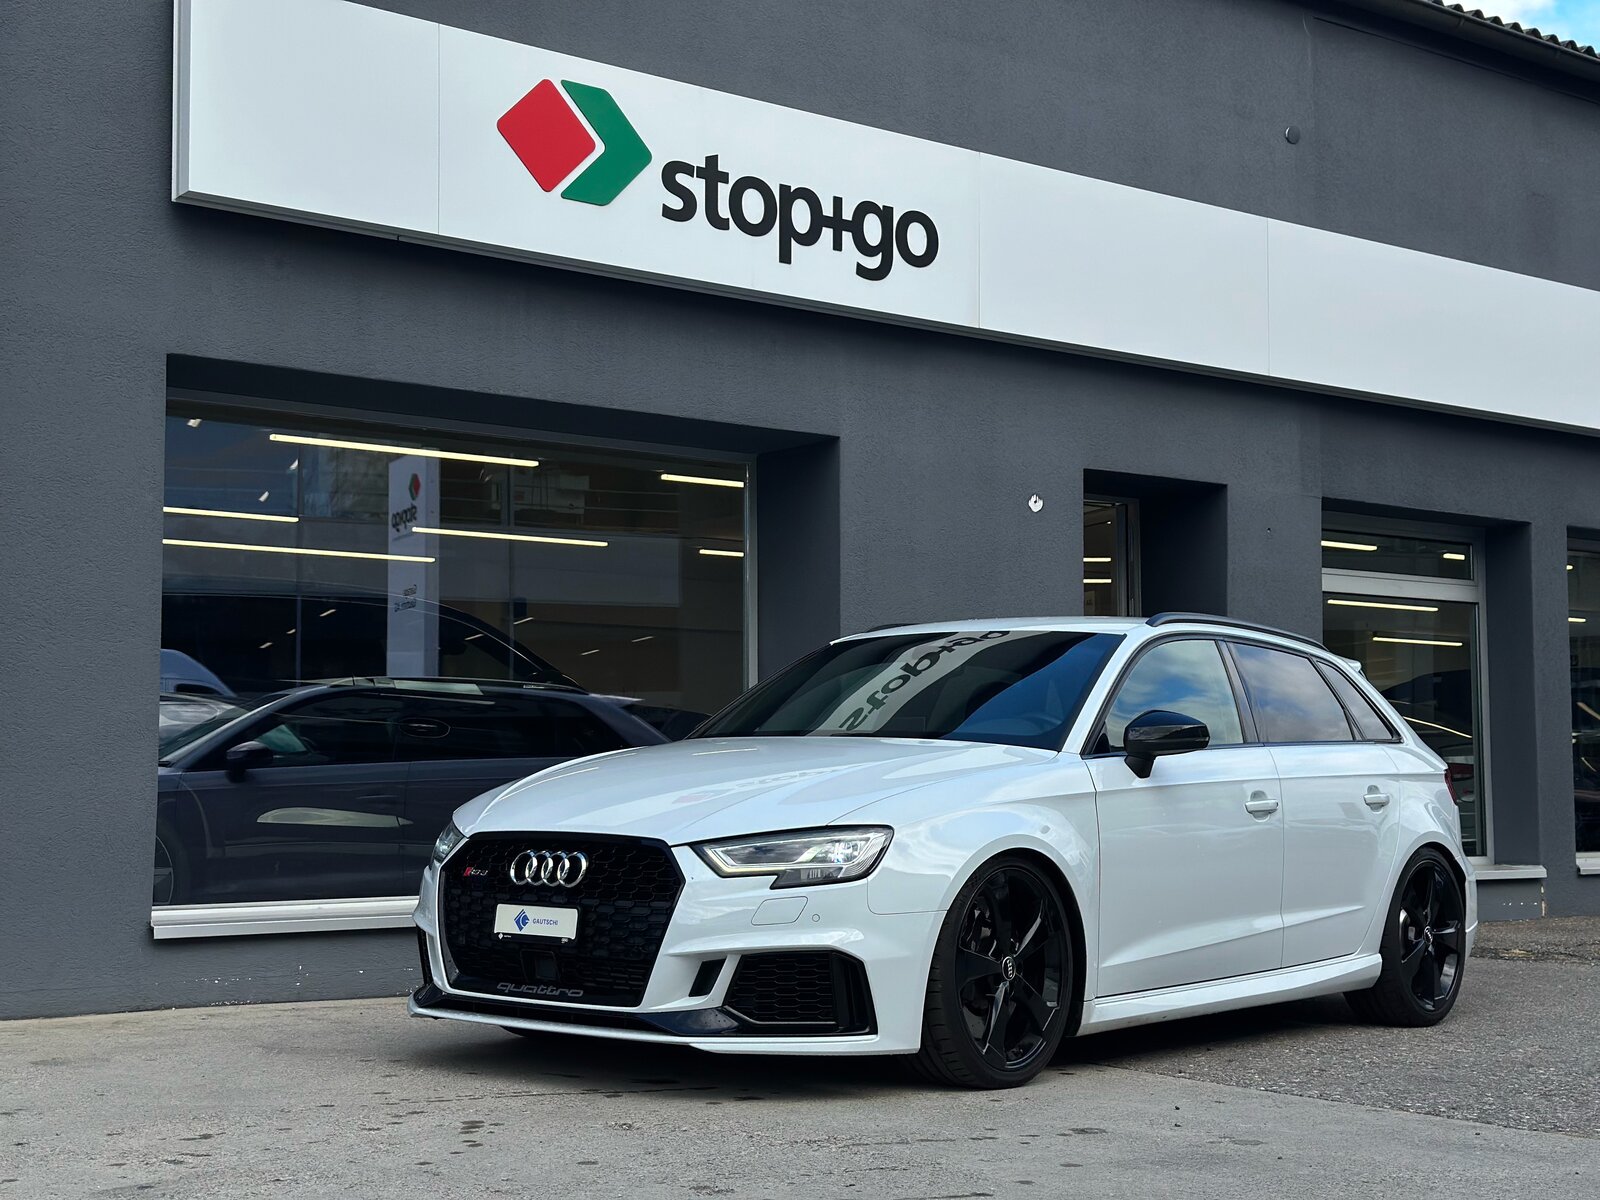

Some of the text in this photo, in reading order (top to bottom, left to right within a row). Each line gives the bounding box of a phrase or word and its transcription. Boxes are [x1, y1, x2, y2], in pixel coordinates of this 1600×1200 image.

[661, 154, 939, 281] stop+go
[532, 918, 559, 926] GAUTSCHI
[496, 982, 584, 997] quattro
